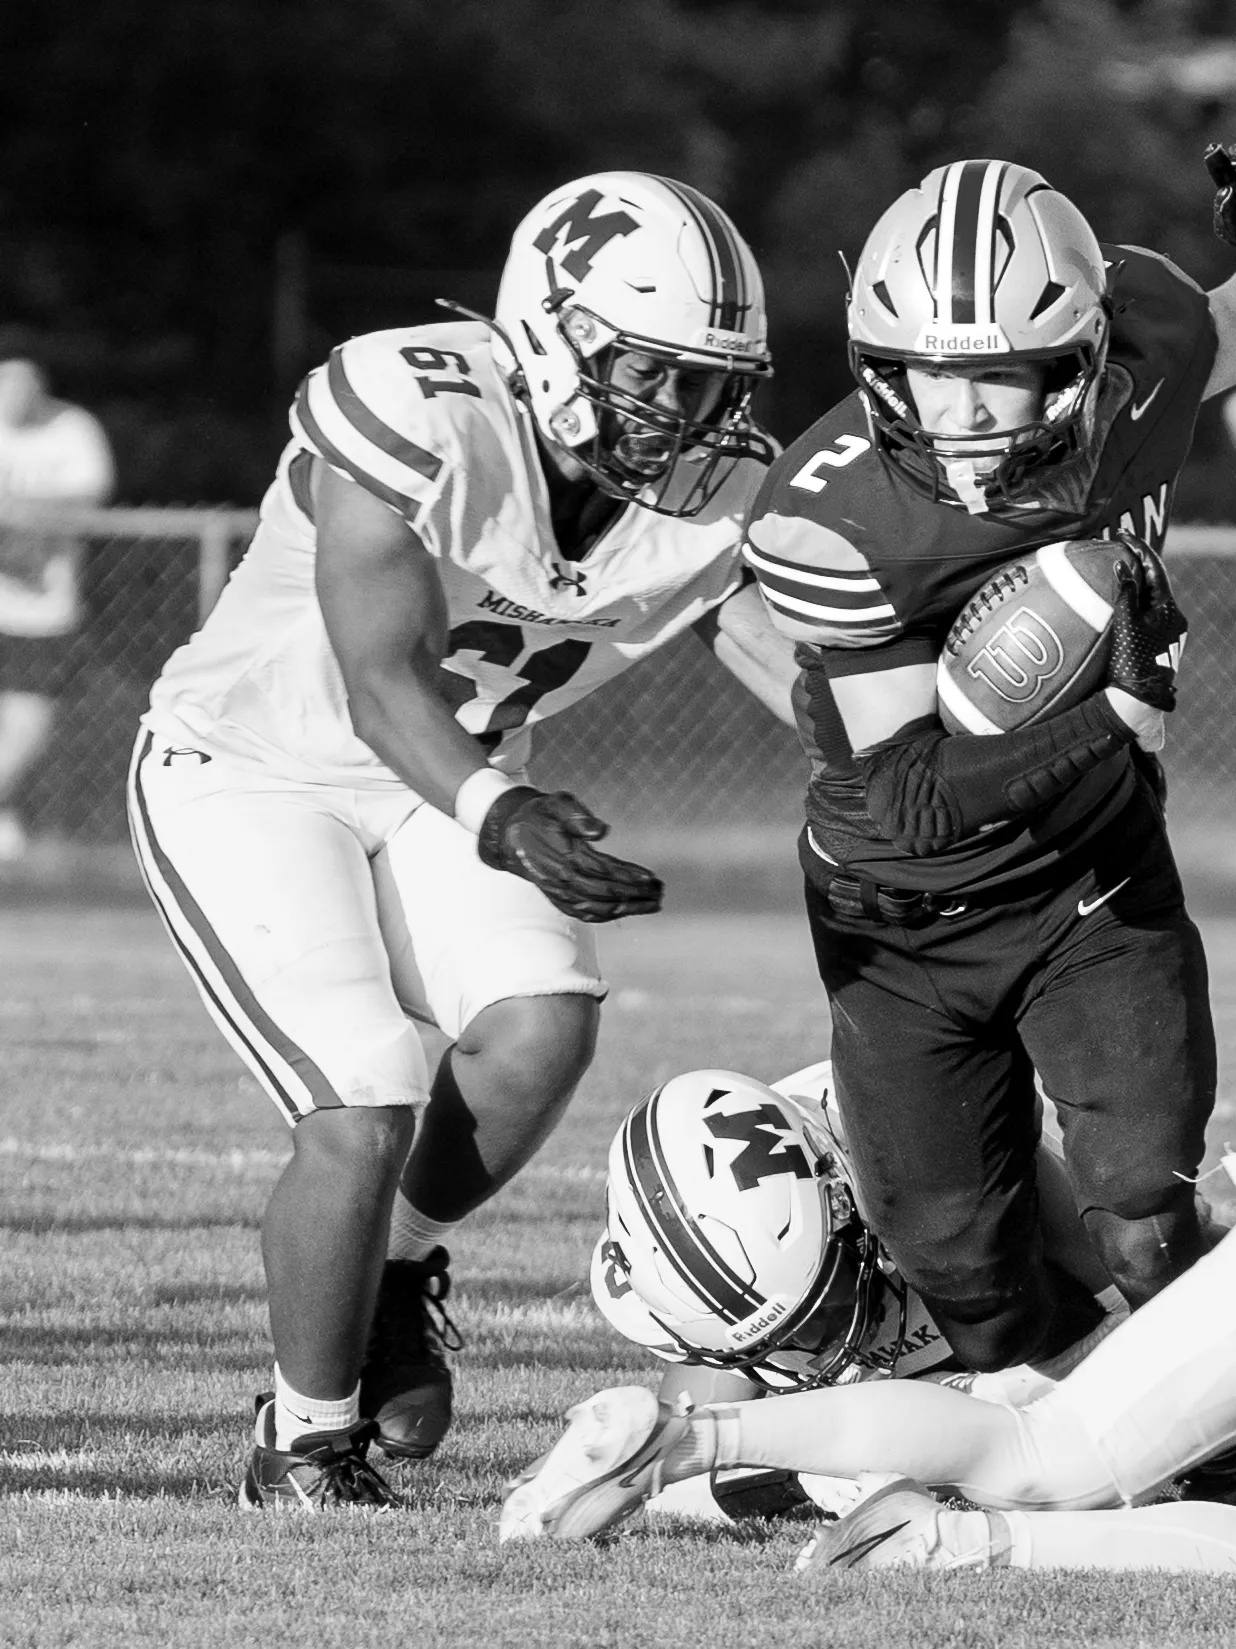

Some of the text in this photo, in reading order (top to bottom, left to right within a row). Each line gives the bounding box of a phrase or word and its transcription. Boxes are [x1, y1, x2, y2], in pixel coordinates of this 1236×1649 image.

[533, 188, 641, 283] M
[925, 335, 999, 350] Riddell
[788, 433, 872, 493] 2
[702, 1102, 812, 1192] M
[732, 1301, 788, 1343] Riddell
